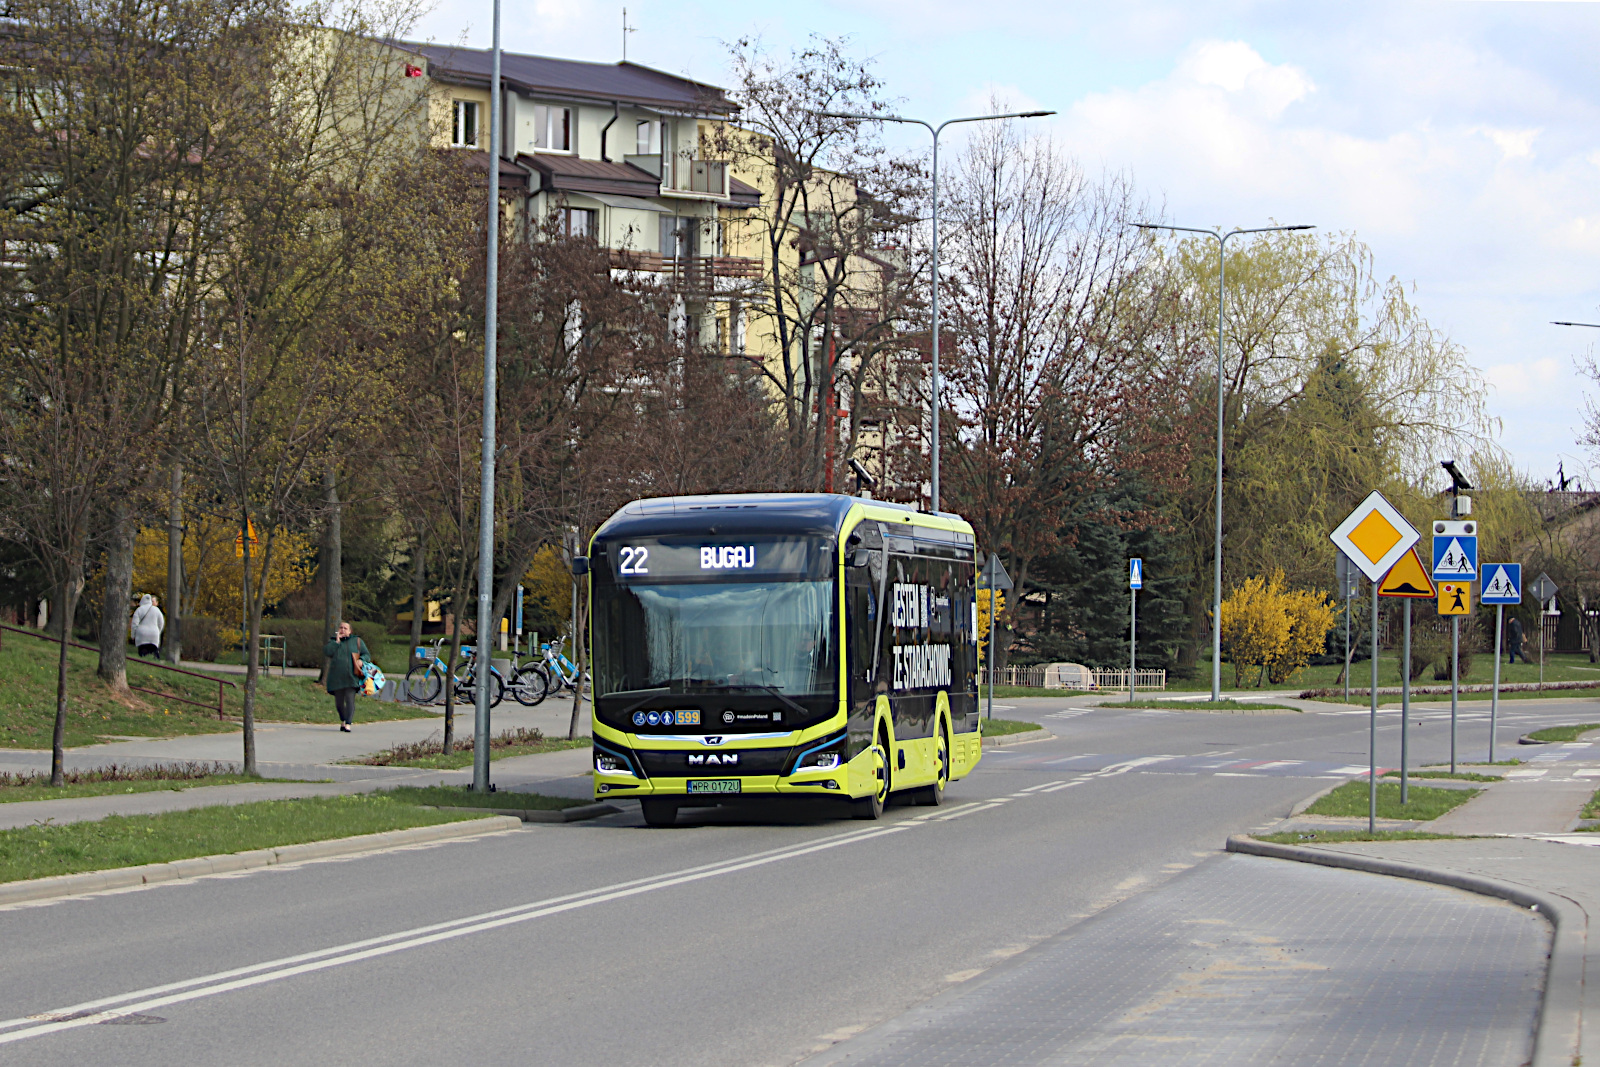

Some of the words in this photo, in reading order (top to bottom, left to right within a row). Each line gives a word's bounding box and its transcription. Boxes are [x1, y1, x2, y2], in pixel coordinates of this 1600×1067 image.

[620, 546, 649, 574] 22
[700, 545, 755, 569] BUGAJ
[892, 583, 919, 627] JESTEM
[893, 645, 902, 689] ZE
[677, 712, 699, 723] 599
[688, 753, 738, 765] MAN
[692, 781, 709, 791] WPR
